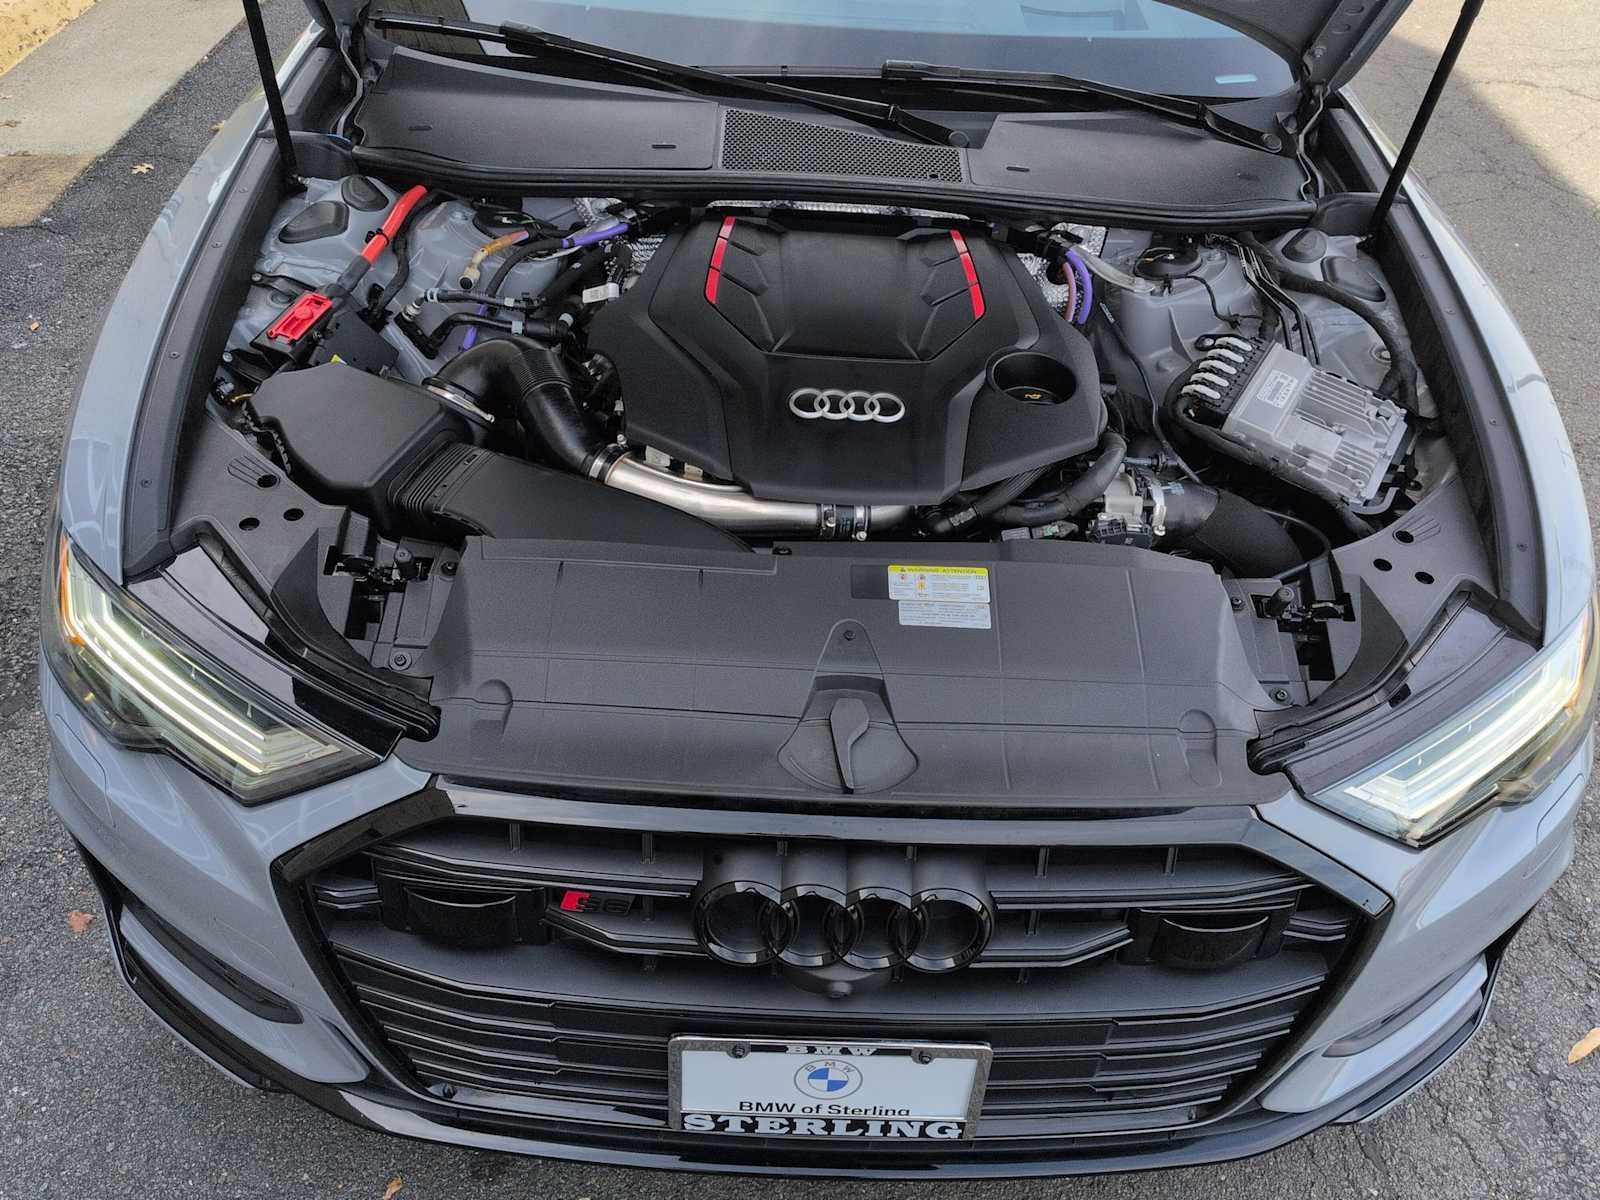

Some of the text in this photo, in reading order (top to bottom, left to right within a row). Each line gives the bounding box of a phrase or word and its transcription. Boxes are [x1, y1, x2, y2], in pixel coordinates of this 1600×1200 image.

[785, 1046, 878, 1056] BMW
[805, 1061, 854, 1073] BMW
[739, 1101, 795, 1113] BMW
[801, 1104, 823, 1114] of
[683, 1114, 964, 1139] STERLING
